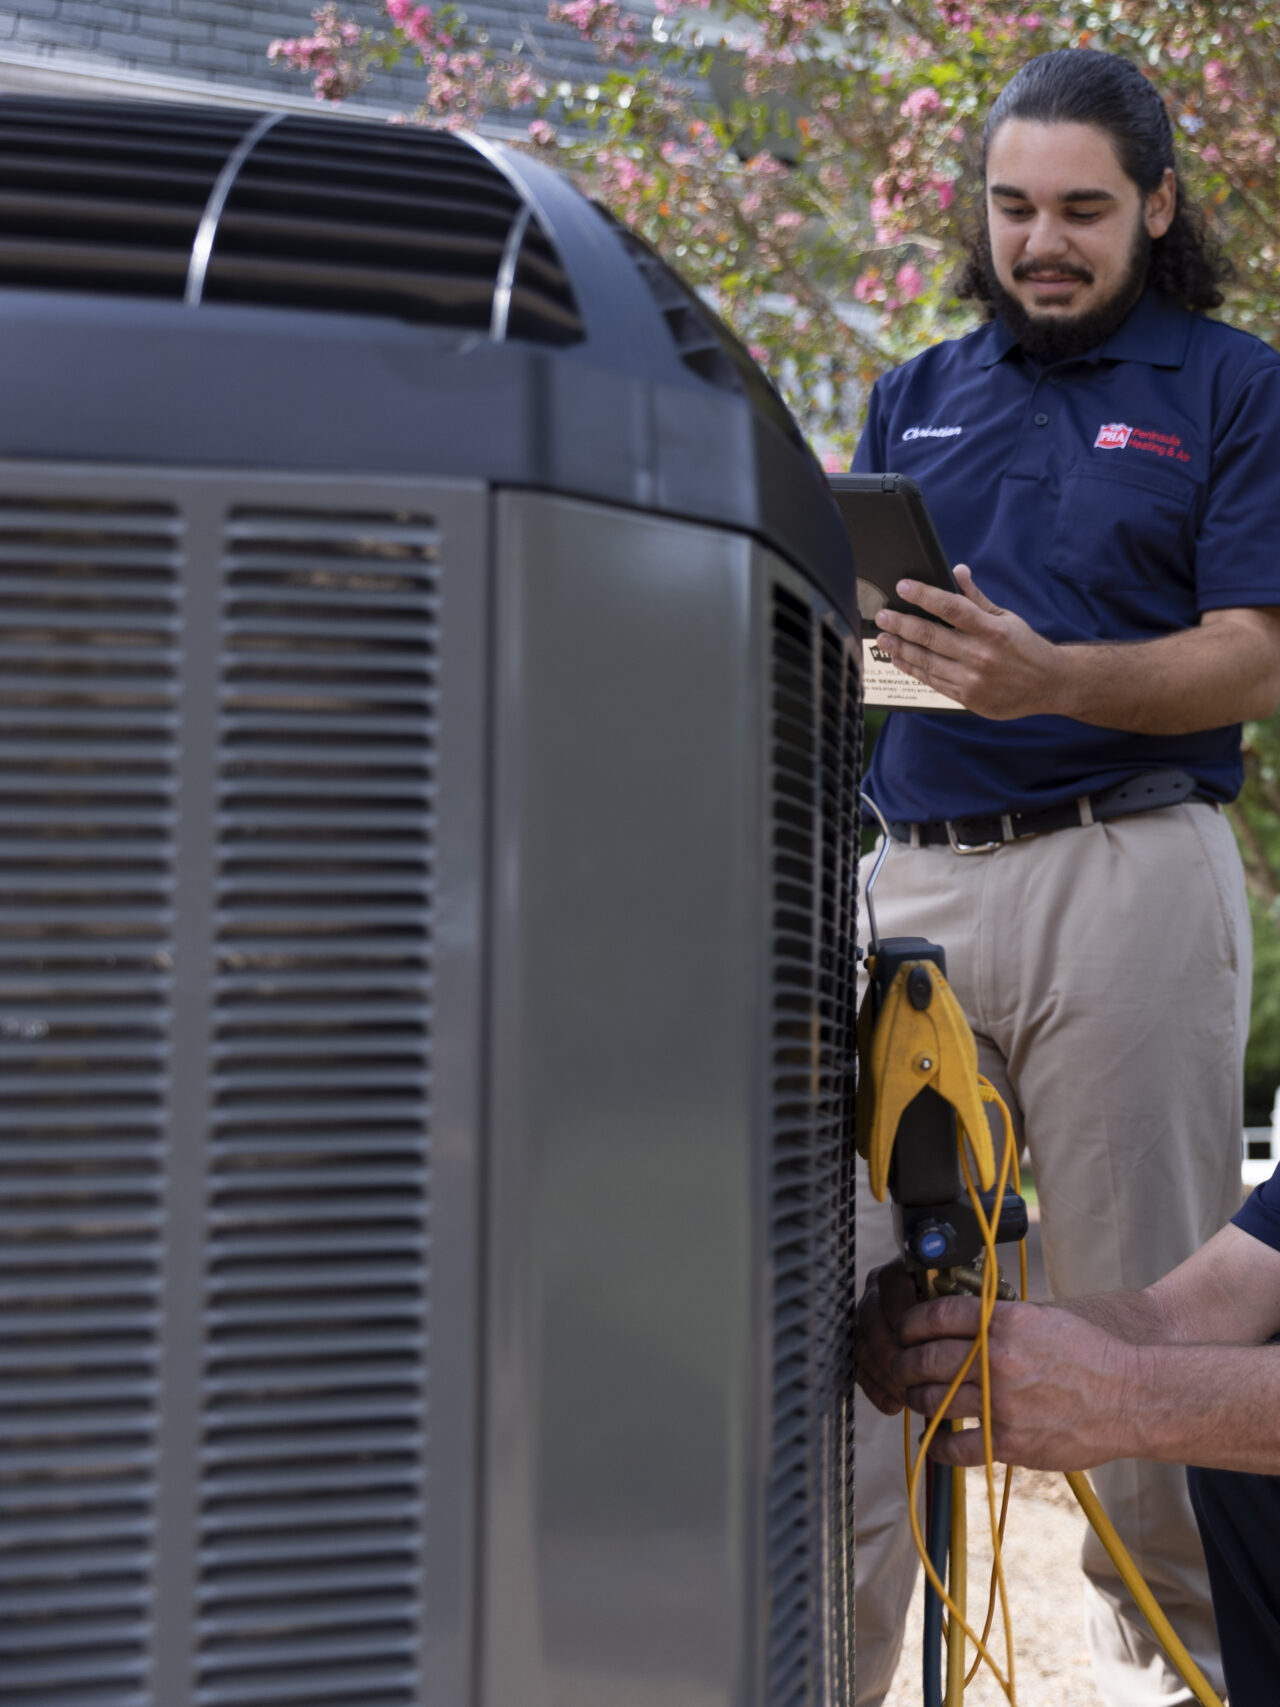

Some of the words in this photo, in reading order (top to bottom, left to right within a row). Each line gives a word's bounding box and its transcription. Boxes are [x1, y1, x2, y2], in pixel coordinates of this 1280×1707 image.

[902, 425, 962, 441] Christian
[1101, 430, 1126, 442] PHA
[1131, 427, 1181, 447] Peninsula
[1127, 438, 1166, 457] Heating
[1176, 449, 1191, 462] Air
